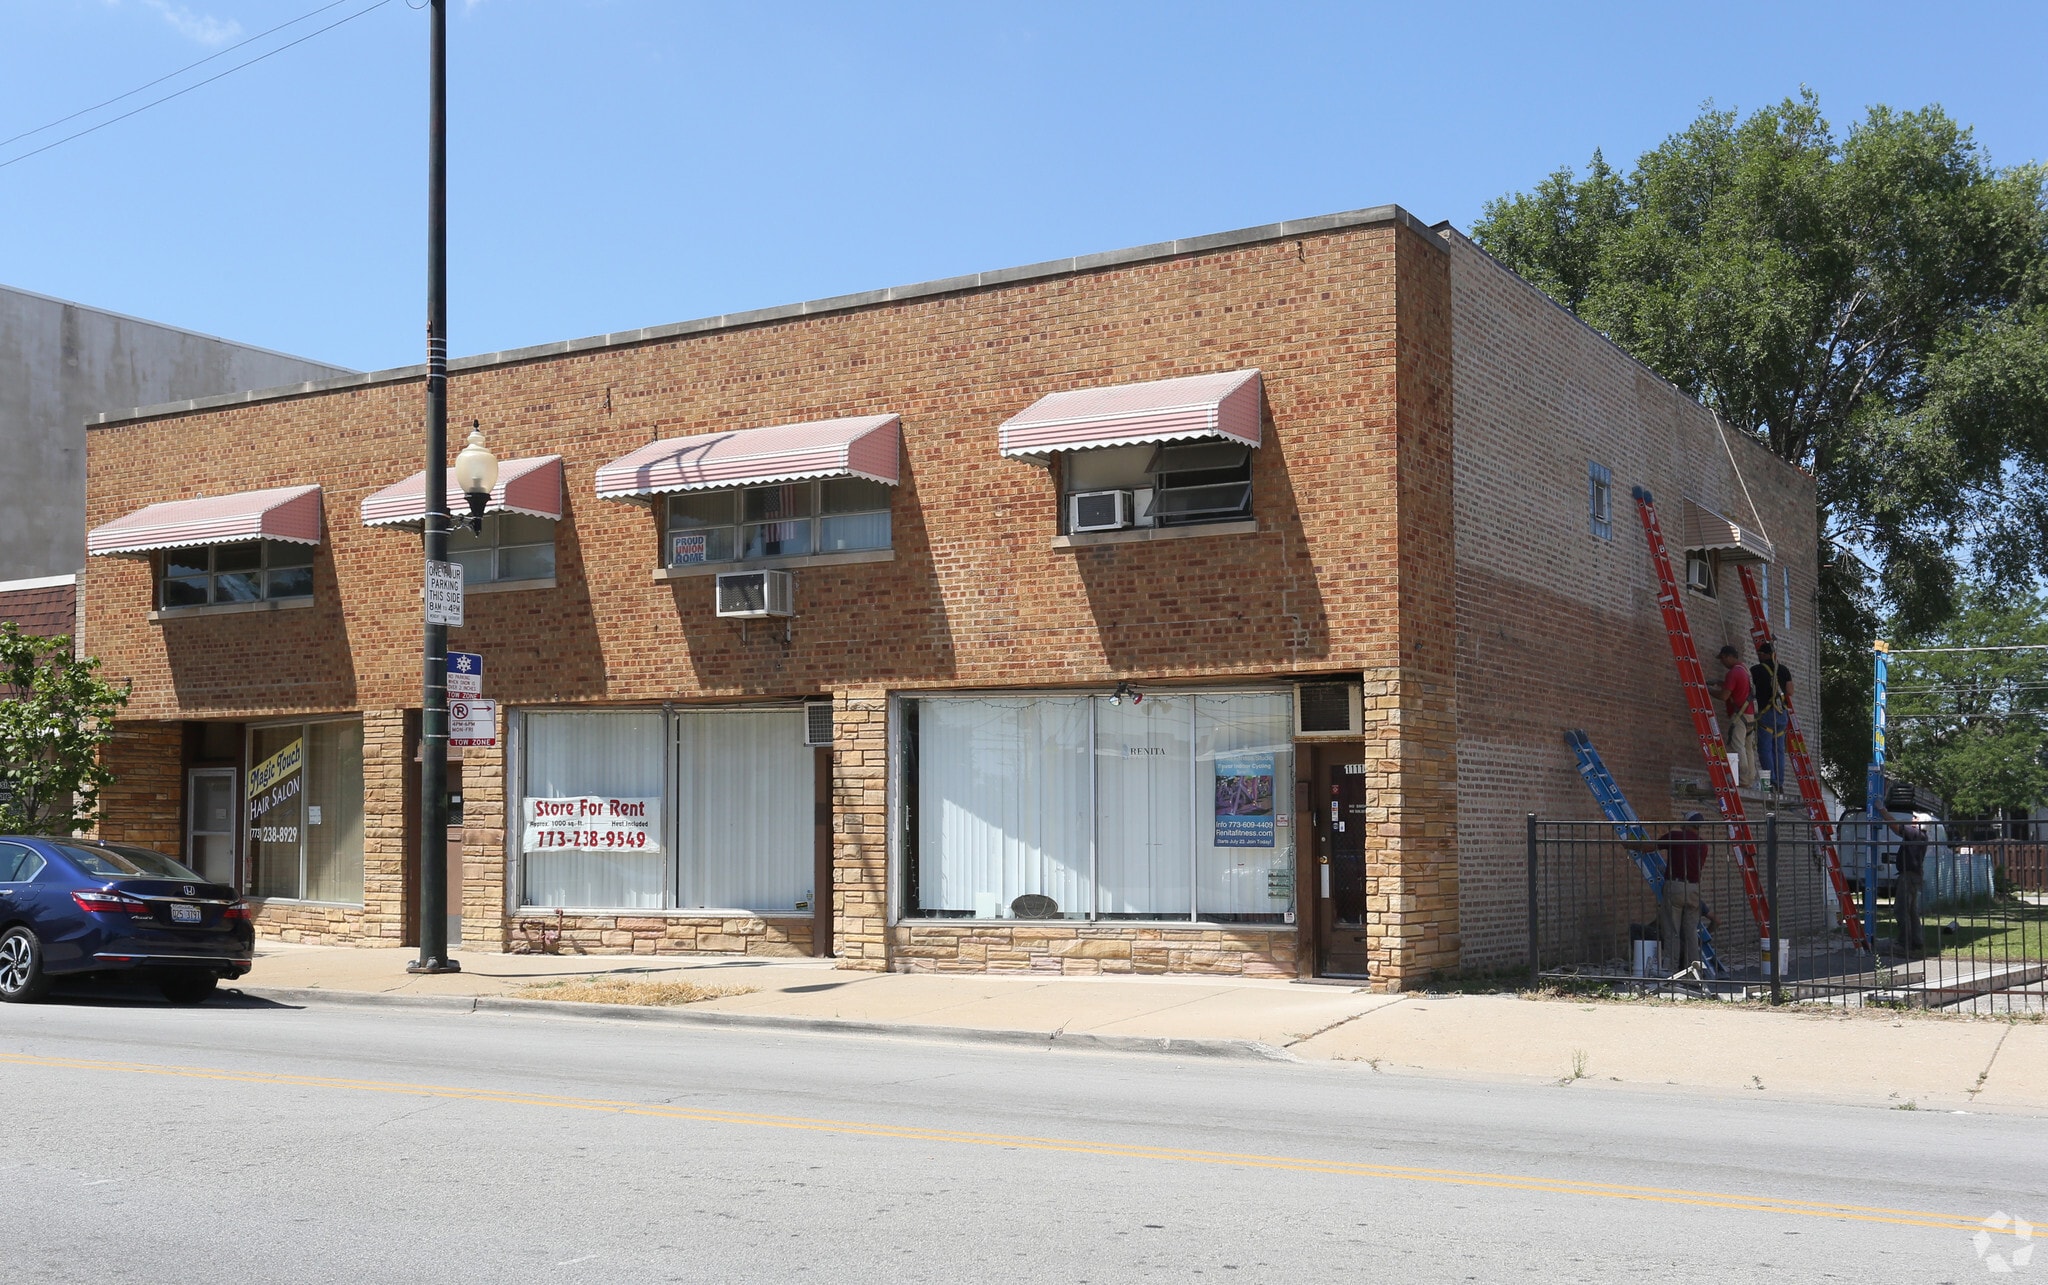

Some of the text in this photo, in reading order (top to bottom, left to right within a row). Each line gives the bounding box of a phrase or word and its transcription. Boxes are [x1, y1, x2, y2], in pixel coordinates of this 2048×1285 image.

[676, 536, 704, 546] PROUD
[676, 545, 704, 554] UNION
[431, 578, 459, 591] PARKING
[429, 590, 461, 603] THIS SIDE
[250, 744, 300, 796] Magic Touch
[250, 776, 300, 820] HAIR SALON
[536, 799, 645, 817] Store For Rent
[263, 827, 297, 842] 238-8929
[538, 831, 646, 848] 773-238-9549
